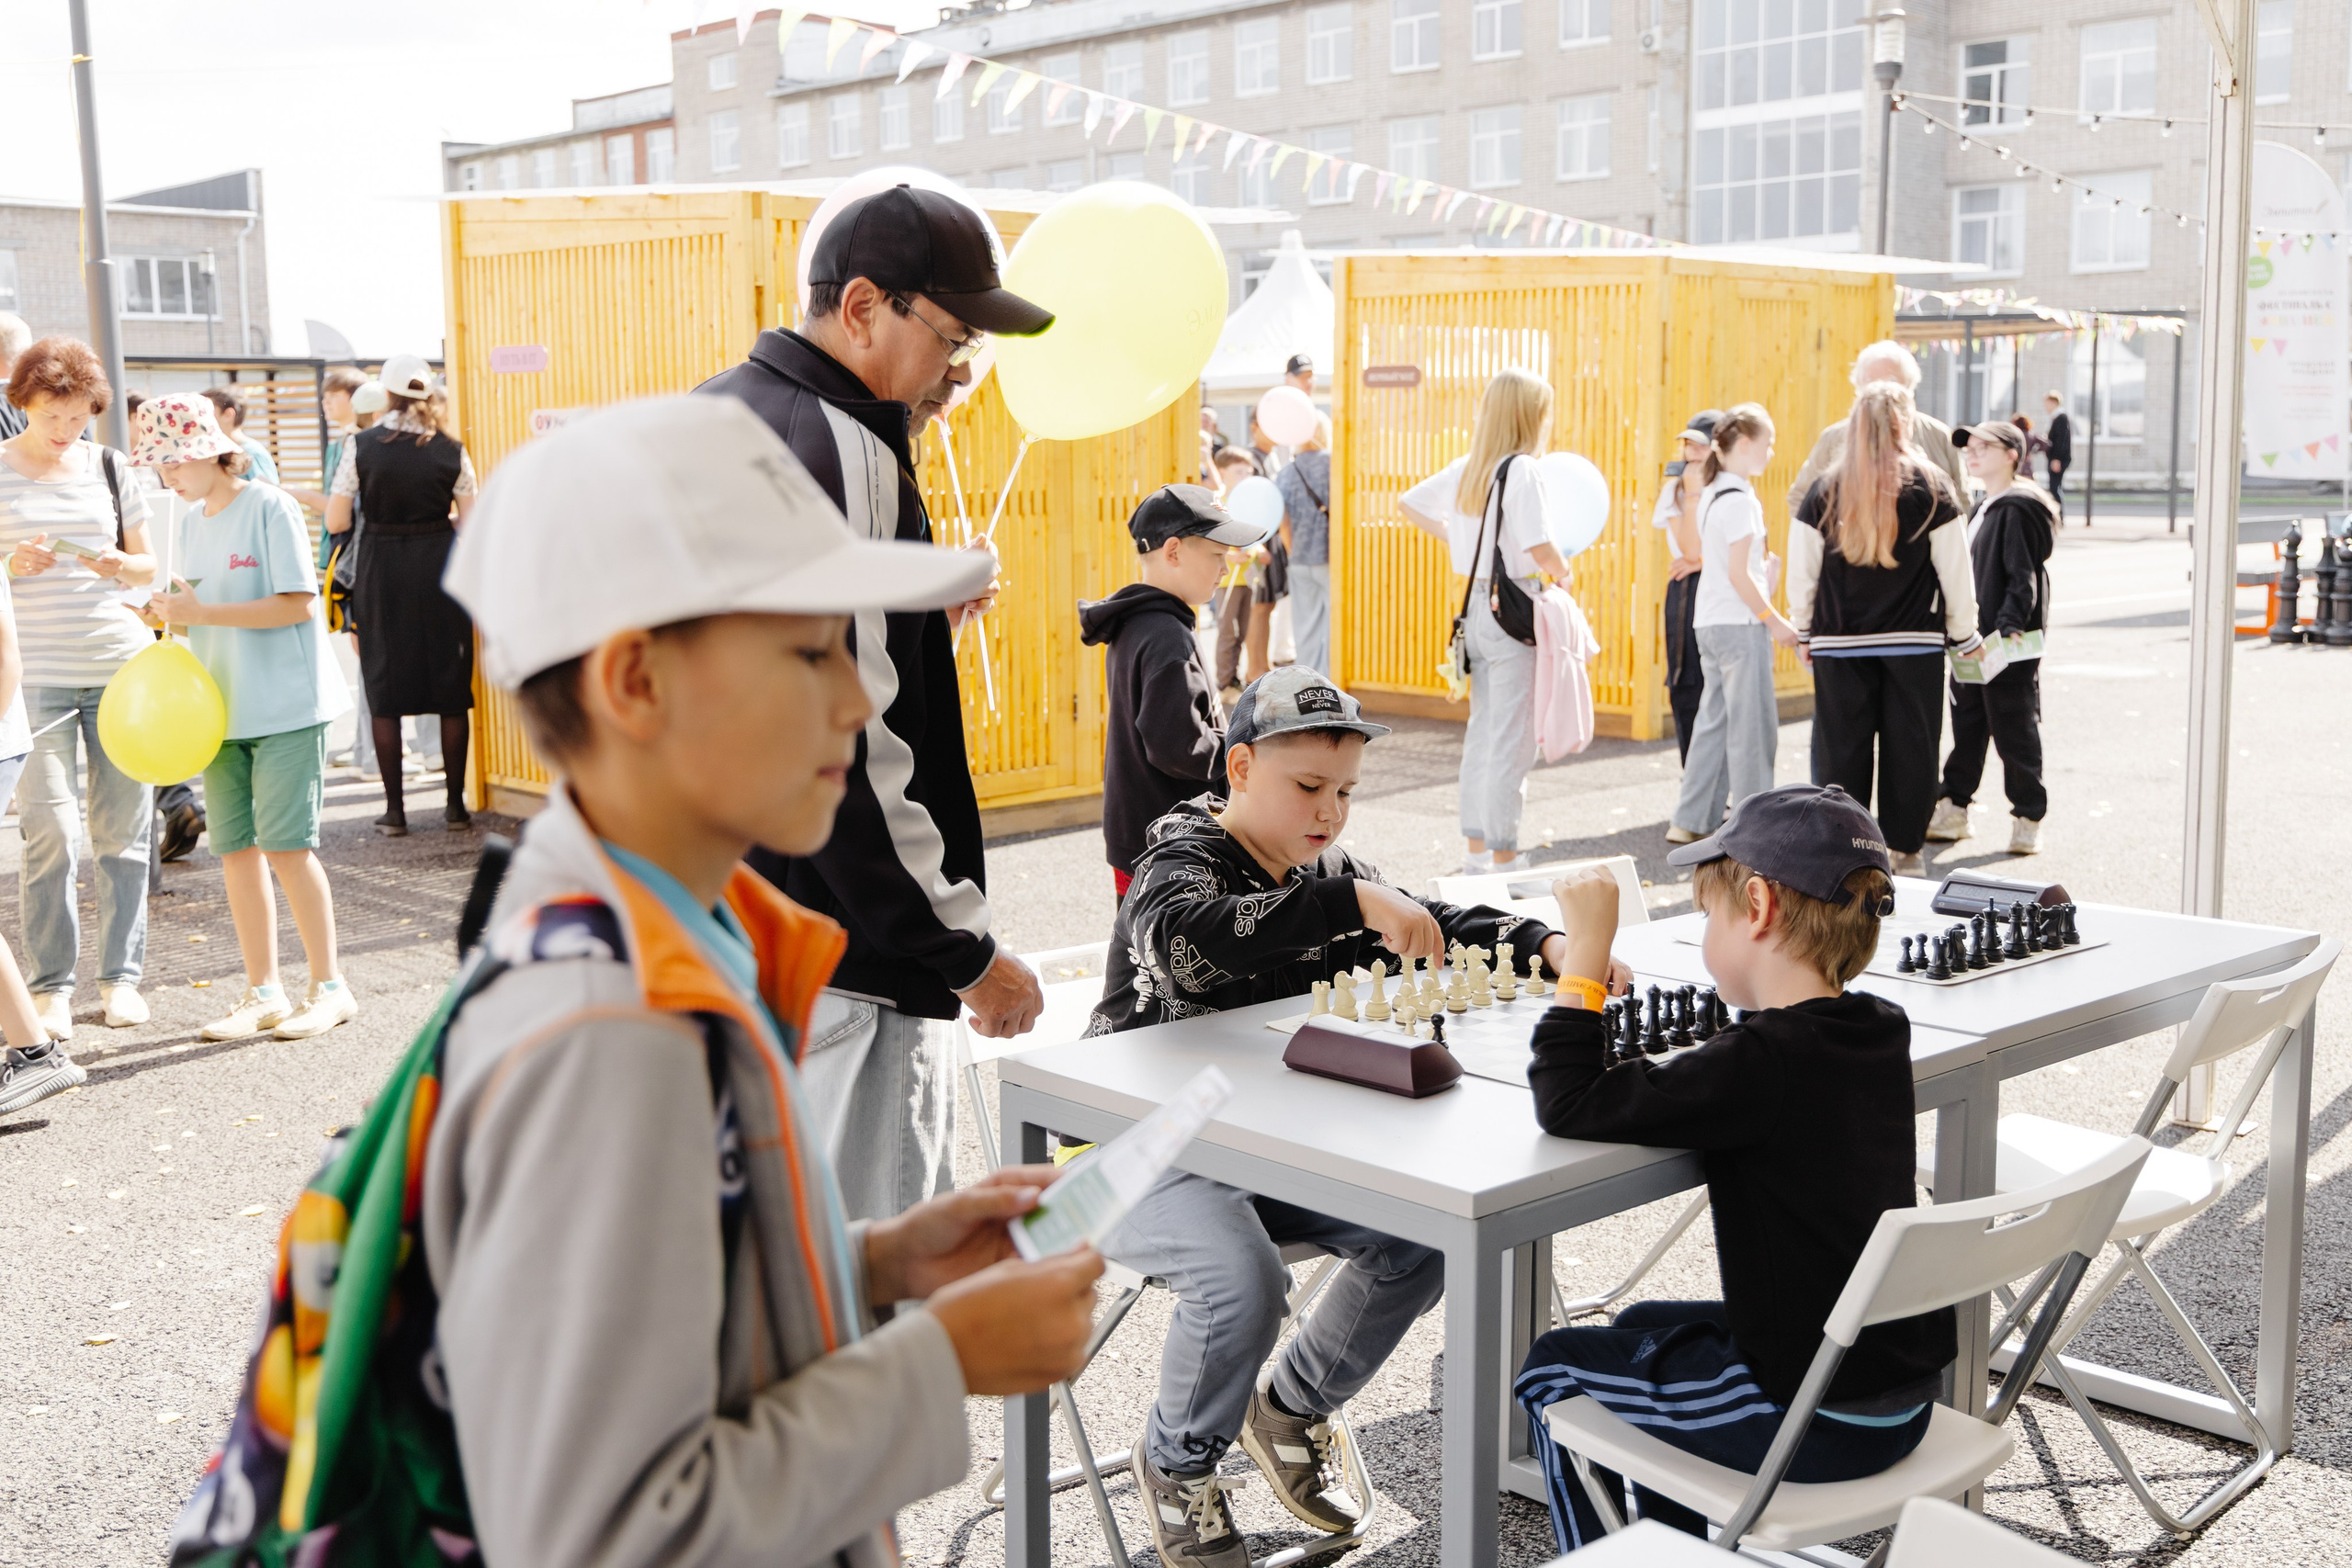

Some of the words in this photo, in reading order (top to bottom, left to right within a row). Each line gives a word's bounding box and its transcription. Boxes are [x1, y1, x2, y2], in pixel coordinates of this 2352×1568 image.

[229, 553, 259, 570] Barbie
[1298, 689, 1335, 701] NEVER
[1851, 837, 1884, 854] HYUNDA
[1170, 935, 1202, 993] adida
[1630, 1336, 1651, 1364] adidas
